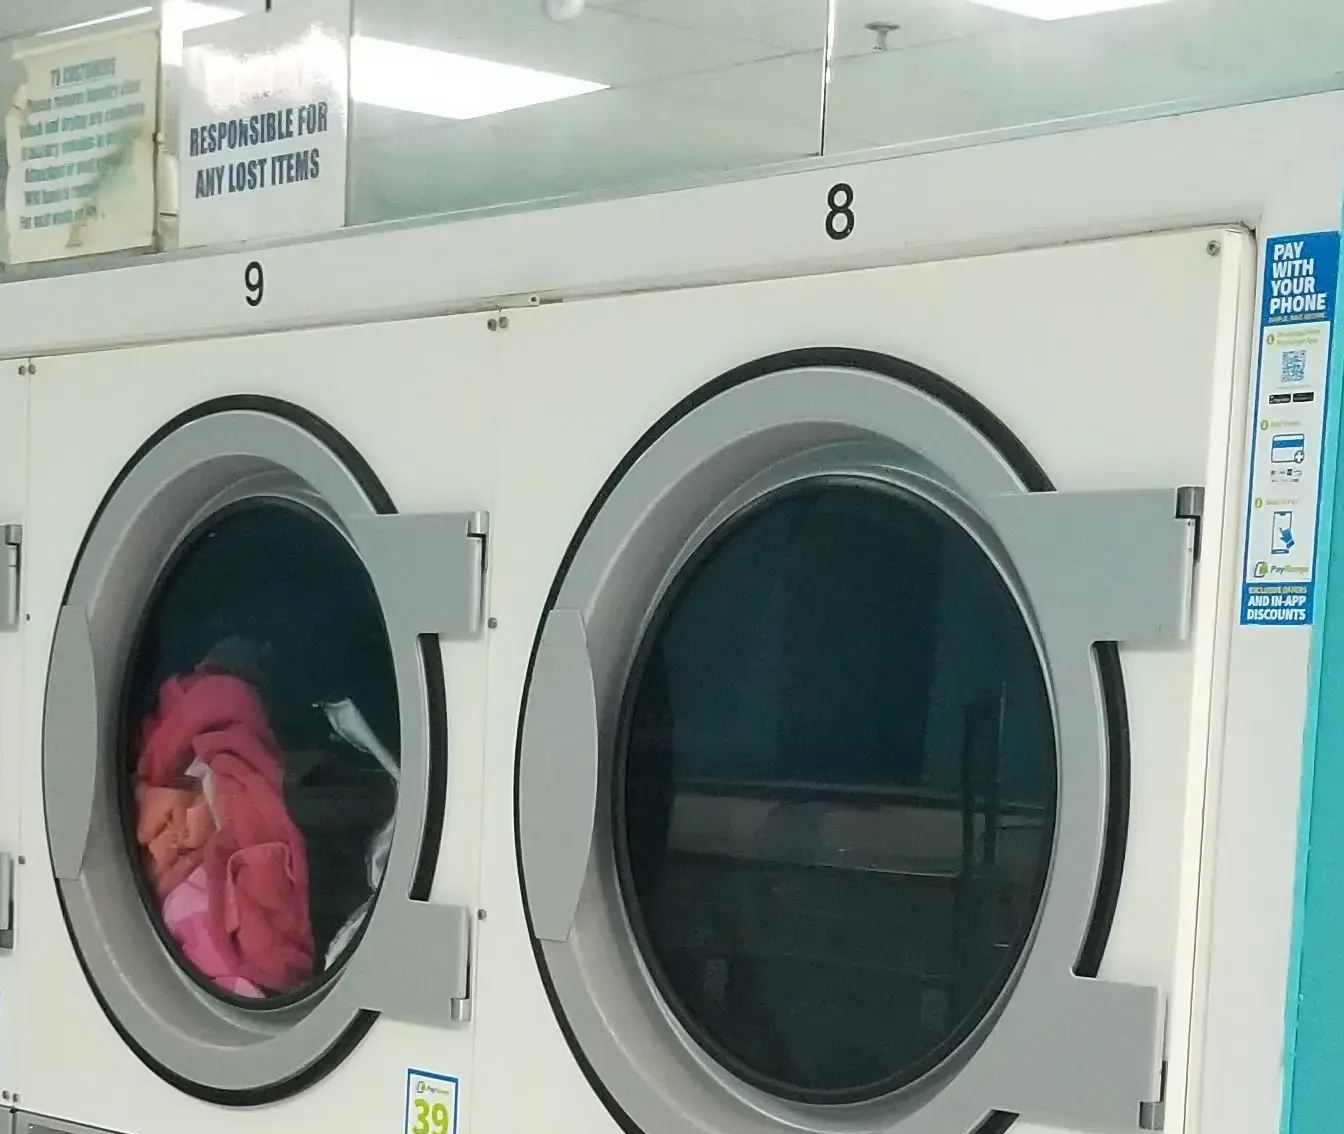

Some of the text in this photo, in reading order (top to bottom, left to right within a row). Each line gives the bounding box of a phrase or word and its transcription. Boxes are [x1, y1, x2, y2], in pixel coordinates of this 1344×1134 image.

[189, 108, 294, 157] RESPONSIBLE
[297, 101, 328, 136] FOR
[195, 148, 320, 199] ANY LOST ITEMS
[825, 182, 855, 240] 8
[1273, 241, 1304, 261] PAY
[1272, 258, 1314, 278] WITH
[245, 261, 263, 306] 9
[1271, 276, 1316, 296] YOUR
[1269, 293, 1327, 314] PHONE
[1248, 595, 1307, 606] AND IN-APP
[1247, 608, 1306, 621] DISCOUNTS
